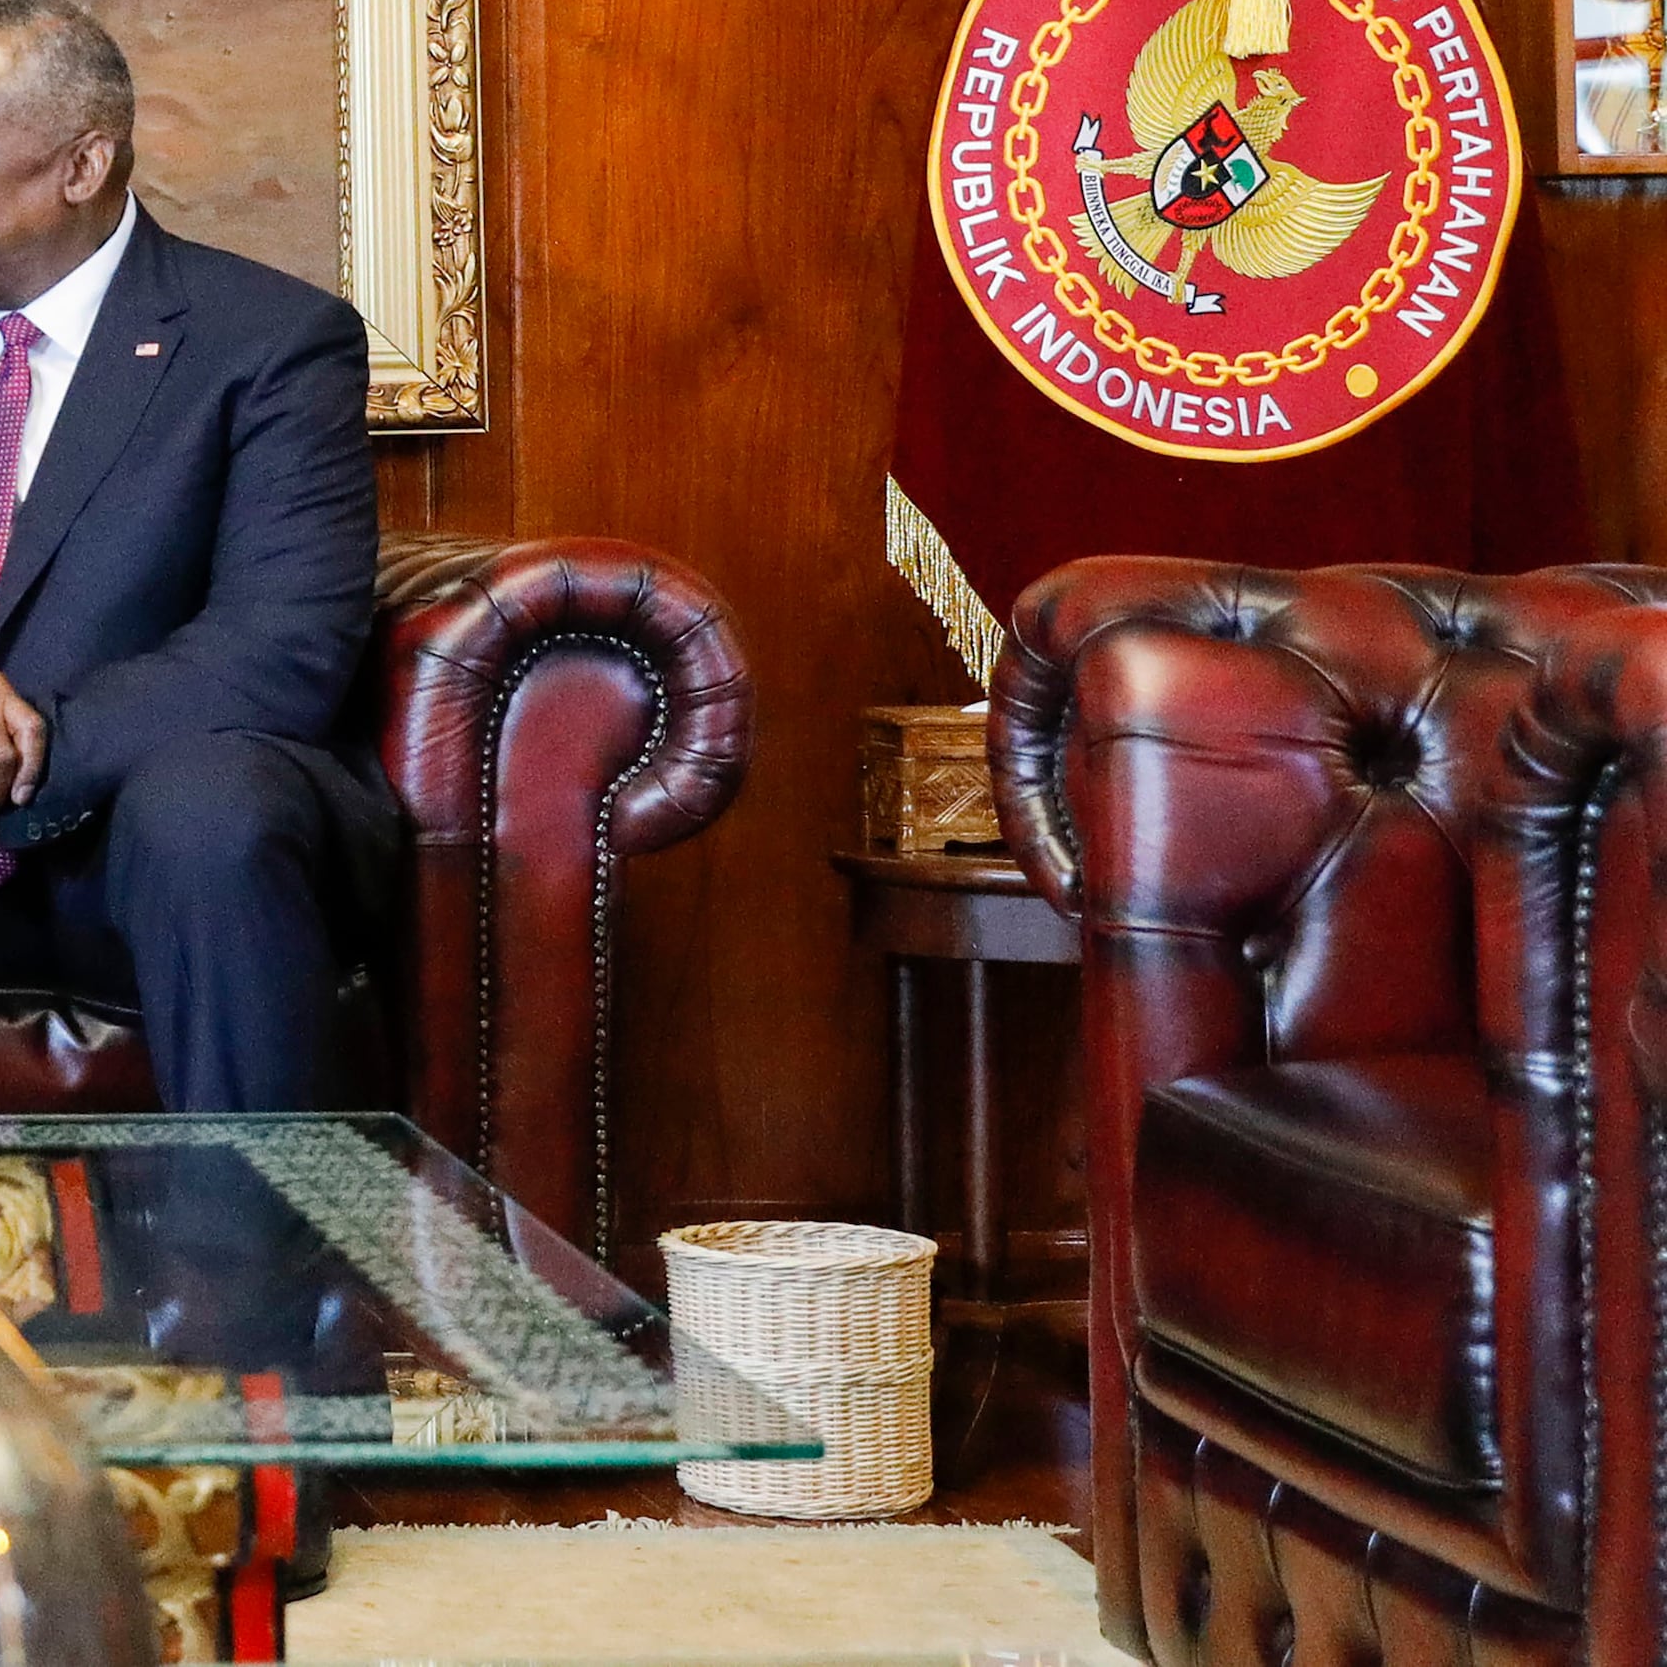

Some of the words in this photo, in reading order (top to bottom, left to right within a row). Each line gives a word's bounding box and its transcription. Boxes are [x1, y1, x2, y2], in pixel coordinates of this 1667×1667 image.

[951, 27, 1027, 300] REPUBLIK
[1011, 302, 1292, 437] INDONESIA
[1107, 237, 1152, 281] TUNGGAL
[1151, 274, 1171, 291] IKA
[1397, 5, 1494, 338] PERTAHANAN
